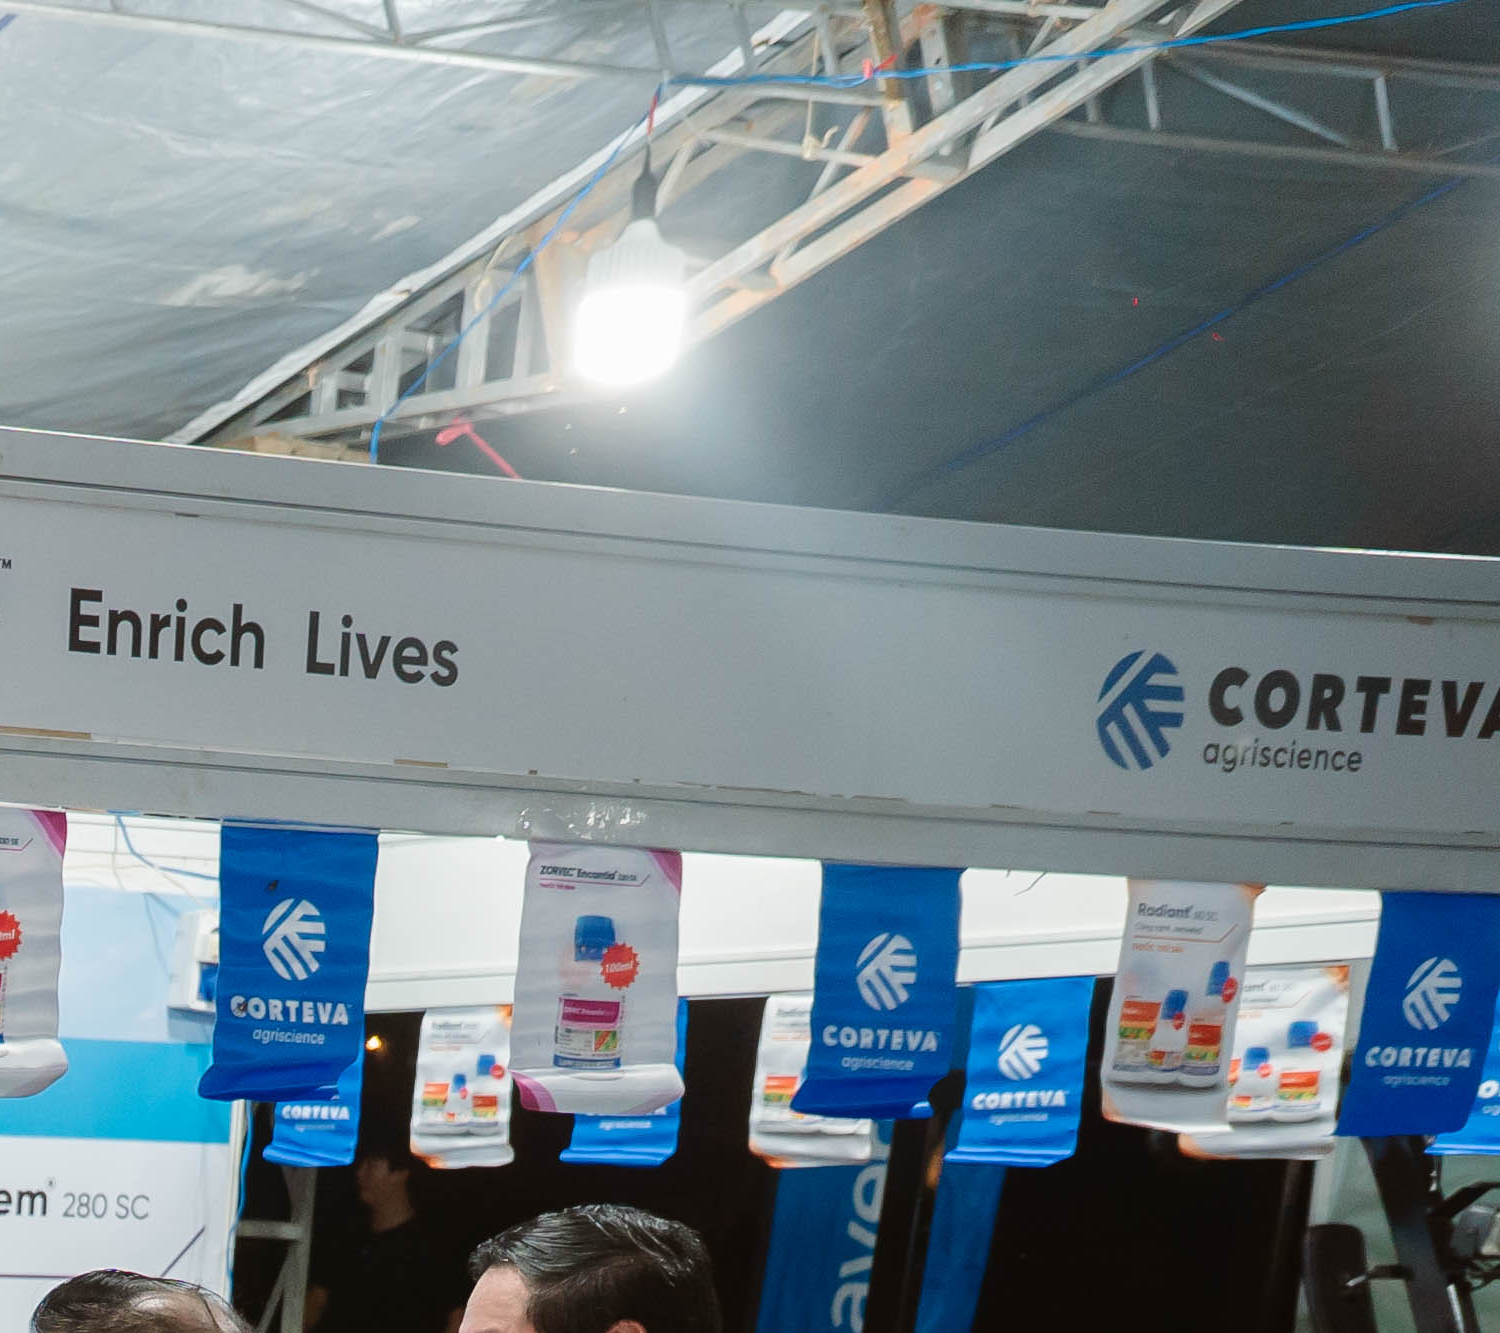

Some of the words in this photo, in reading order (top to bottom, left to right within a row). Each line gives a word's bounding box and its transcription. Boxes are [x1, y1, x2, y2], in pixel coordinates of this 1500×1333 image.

[68, 589, 264, 670] Enrich
[306, 610, 458, 688] Lives
[1203, 738, 1363, 773] agriscience
[252, 1027, 327, 1047] agriscience
[841, 1054, 914, 1072] agriscience
[282, 1105, 350, 1121] CORTEVA
[63, 1195, 108, 1220] 280
[115, 1195, 150, 1220] SC
